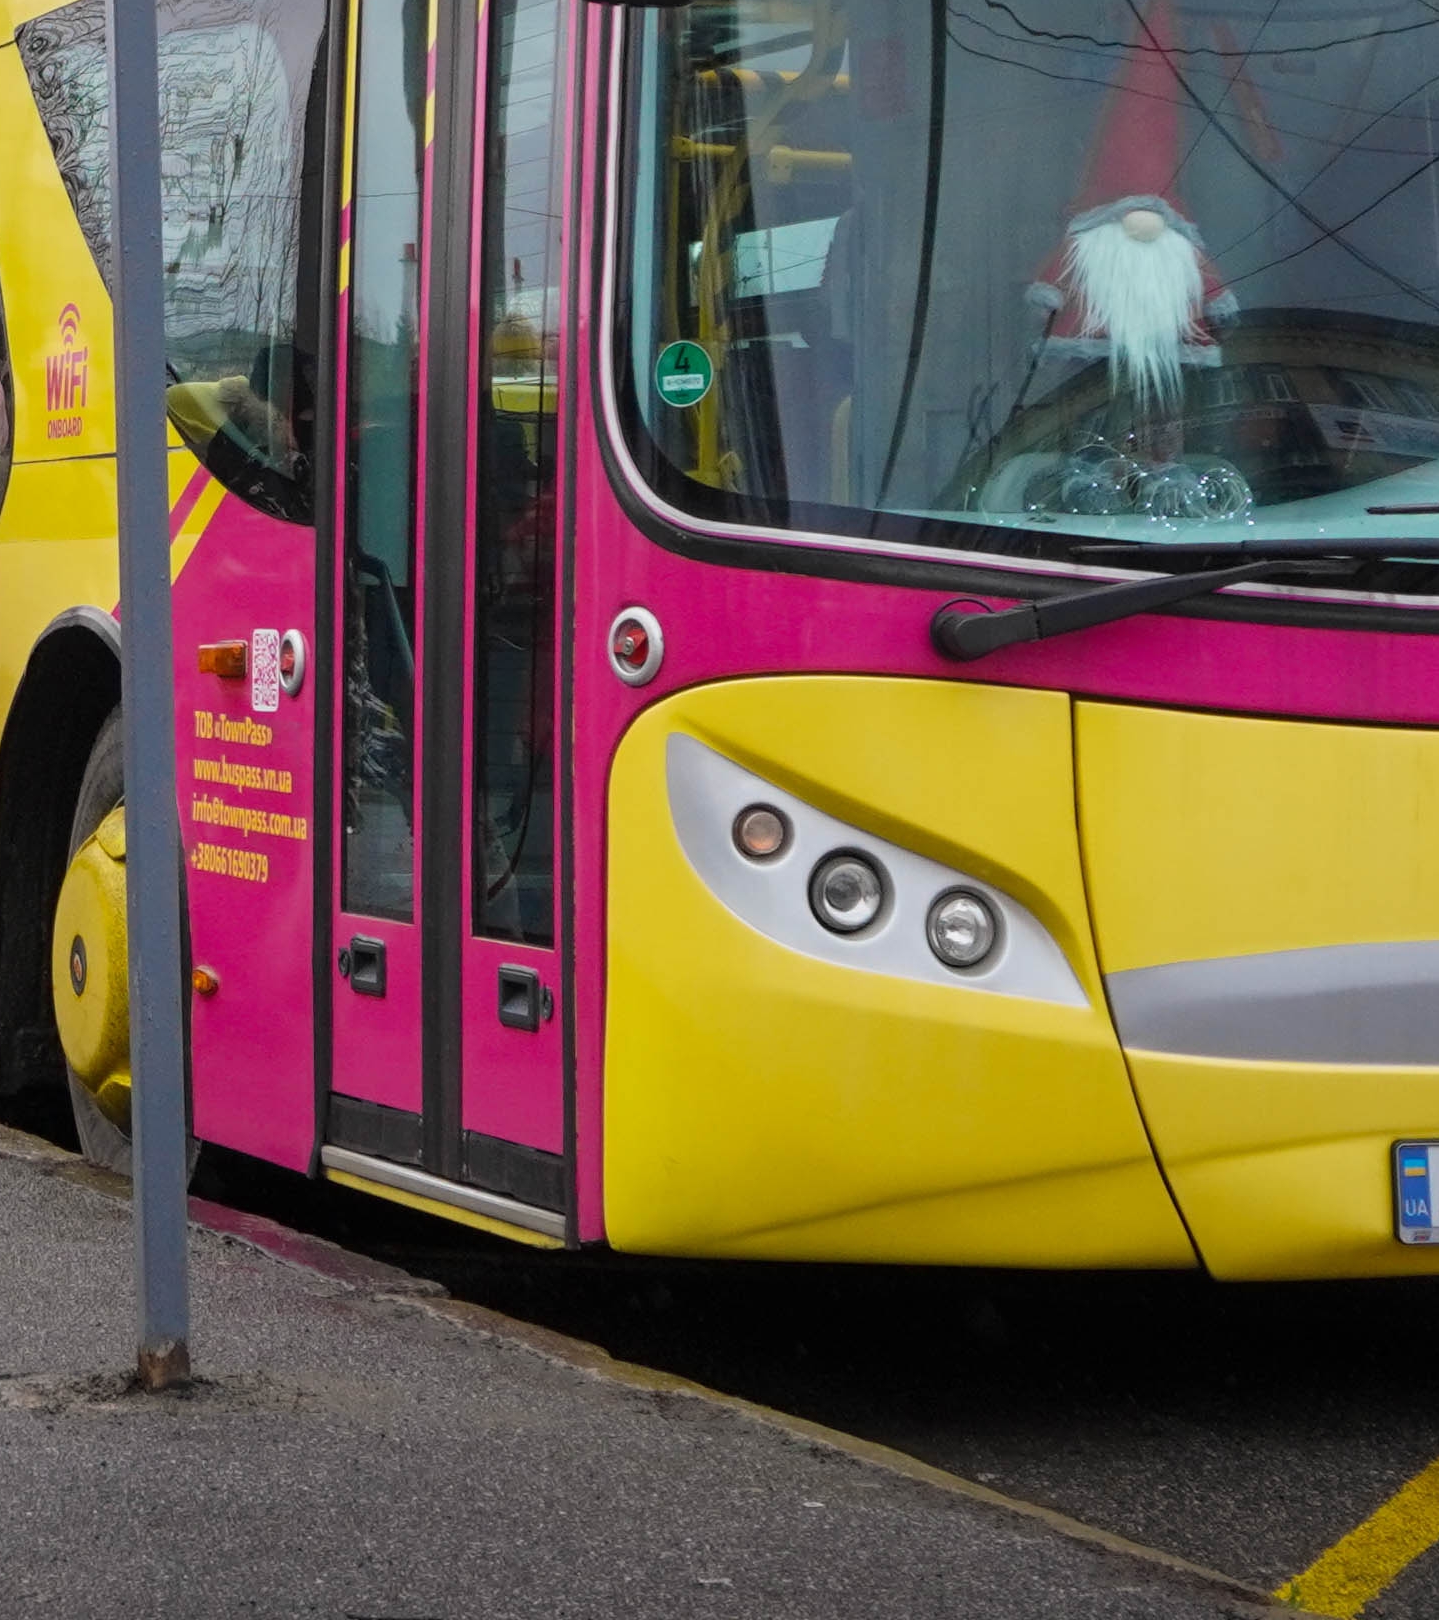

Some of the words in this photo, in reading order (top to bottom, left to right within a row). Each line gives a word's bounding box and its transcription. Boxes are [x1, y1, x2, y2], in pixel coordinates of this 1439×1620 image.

[675, 345, 690, 373] 4
[46, 346, 88, 412] WiFi
[47, 416, 83, 439] ONBOARD
[214, 712, 273, 747] «TownPass»
[194, 755, 293, 794] www.buspass.vn.ua
[192, 793, 308, 840] info@townpass.com.ua
[191, 842, 269, 883] +380661690379
[1405, 1199, 1429, 1218] UA
